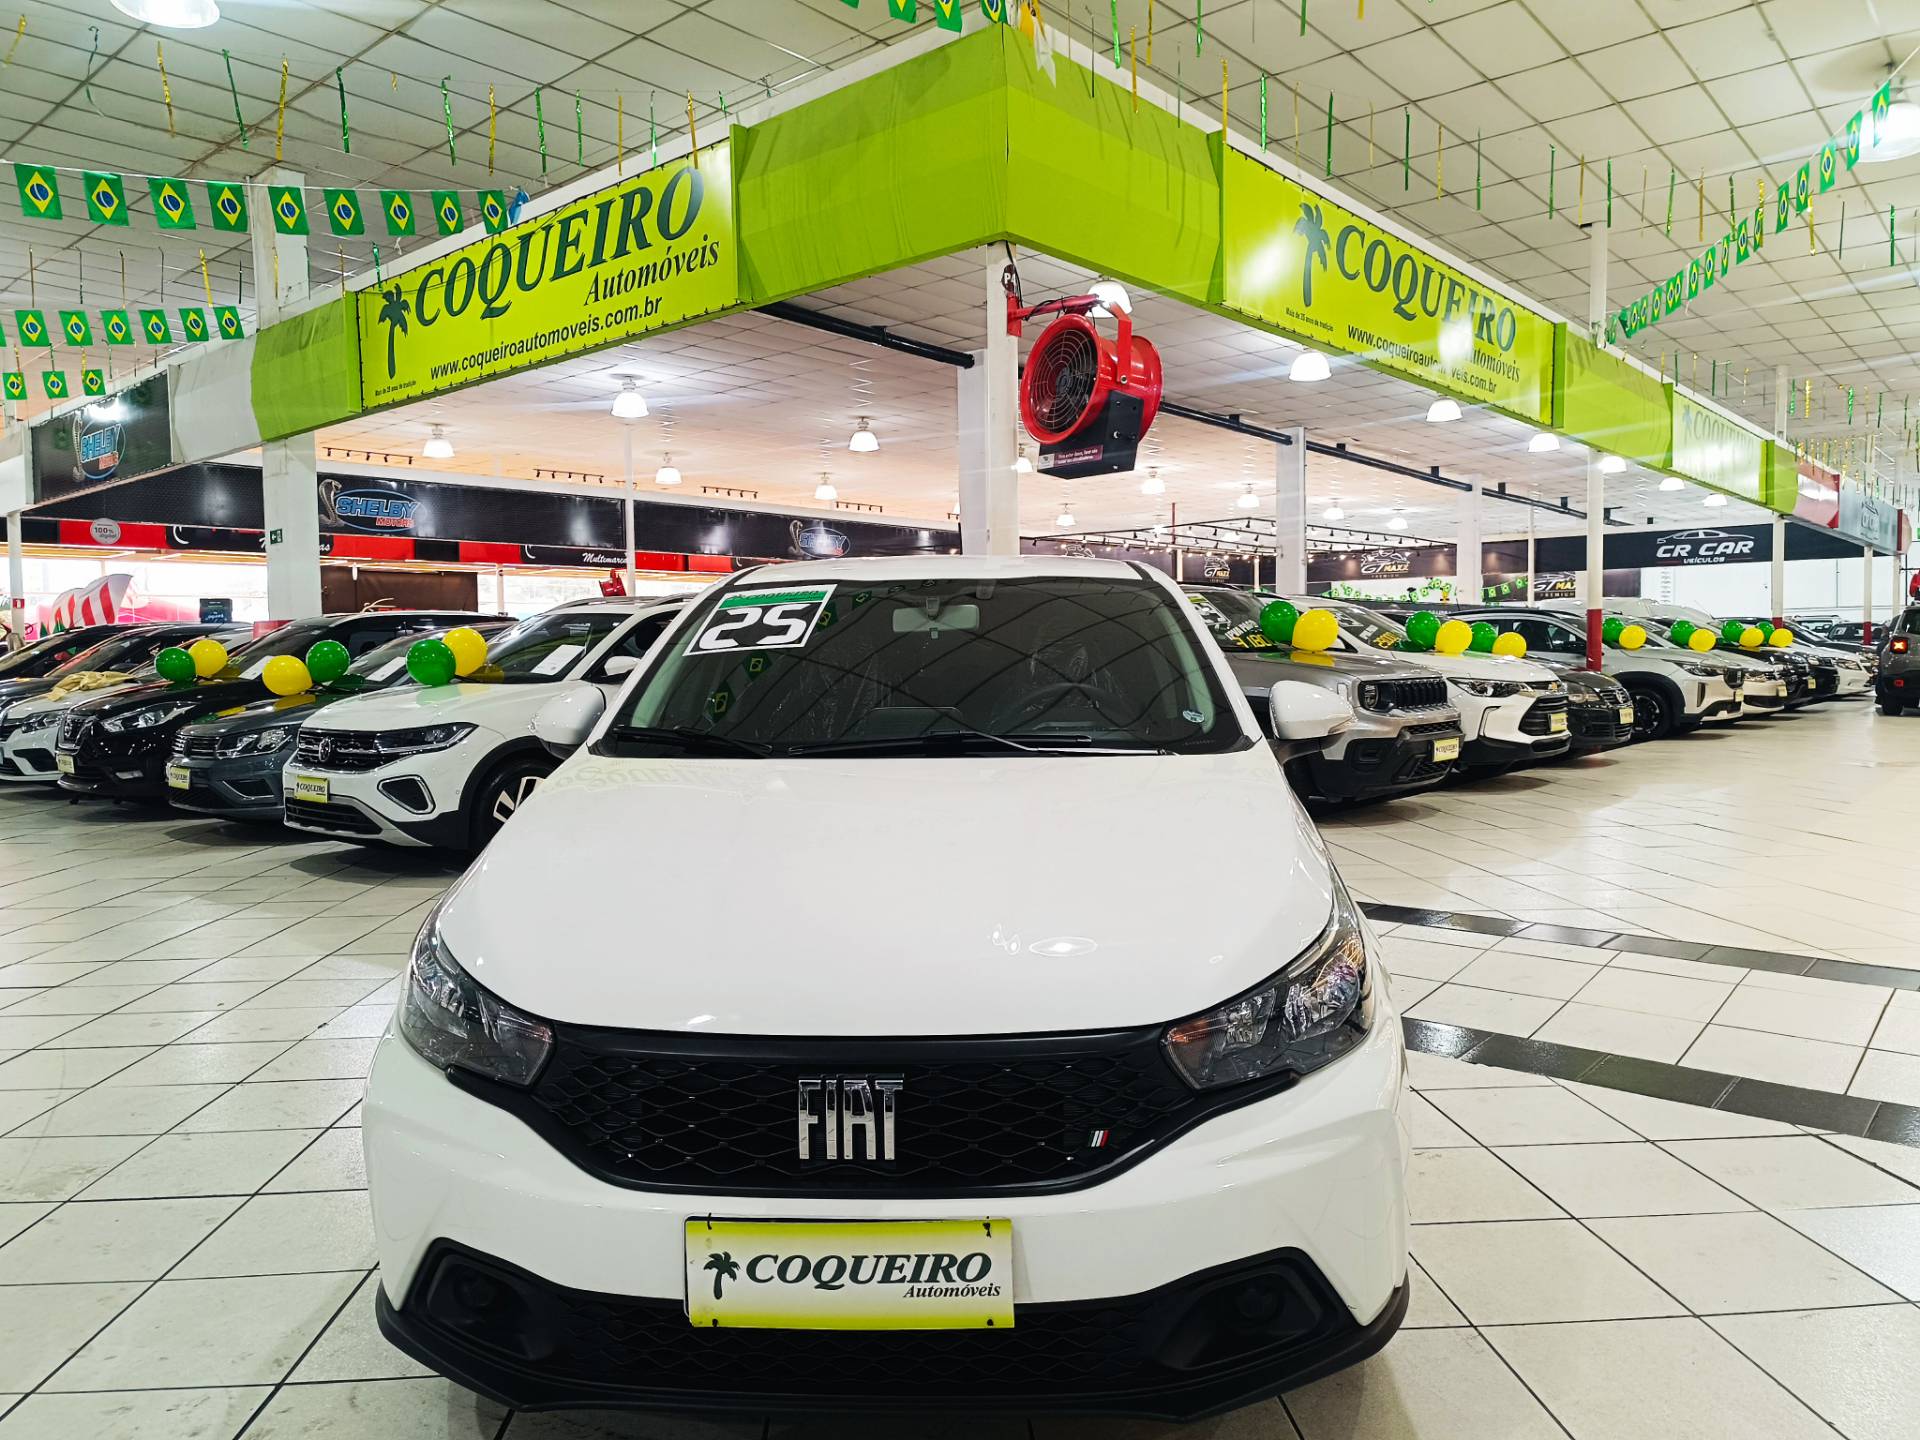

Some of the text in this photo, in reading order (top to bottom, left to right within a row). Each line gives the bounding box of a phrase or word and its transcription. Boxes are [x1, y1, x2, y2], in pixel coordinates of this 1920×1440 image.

[415, 166, 704, 326] COQUEIRO
[584, 234, 719, 306] Automóveis
[1336, 224, 1516, 352] COQUEIRO
[430, 296, 663, 380] www.coqueiroautomoveis.com.br
[1467, 348, 1520, 383] utomóveis
[80, 424, 120, 463] SHELBY
[336, 496, 419, 519] SHELBY
[1656, 541, 1754, 557] CR CAR
[699, 604, 806, 649] 25
[799, 1080, 903, 1160] FIAT
[746, 1252, 992, 1290] COQUEIRO
[903, 1284, 1001, 1299] Automóveis
